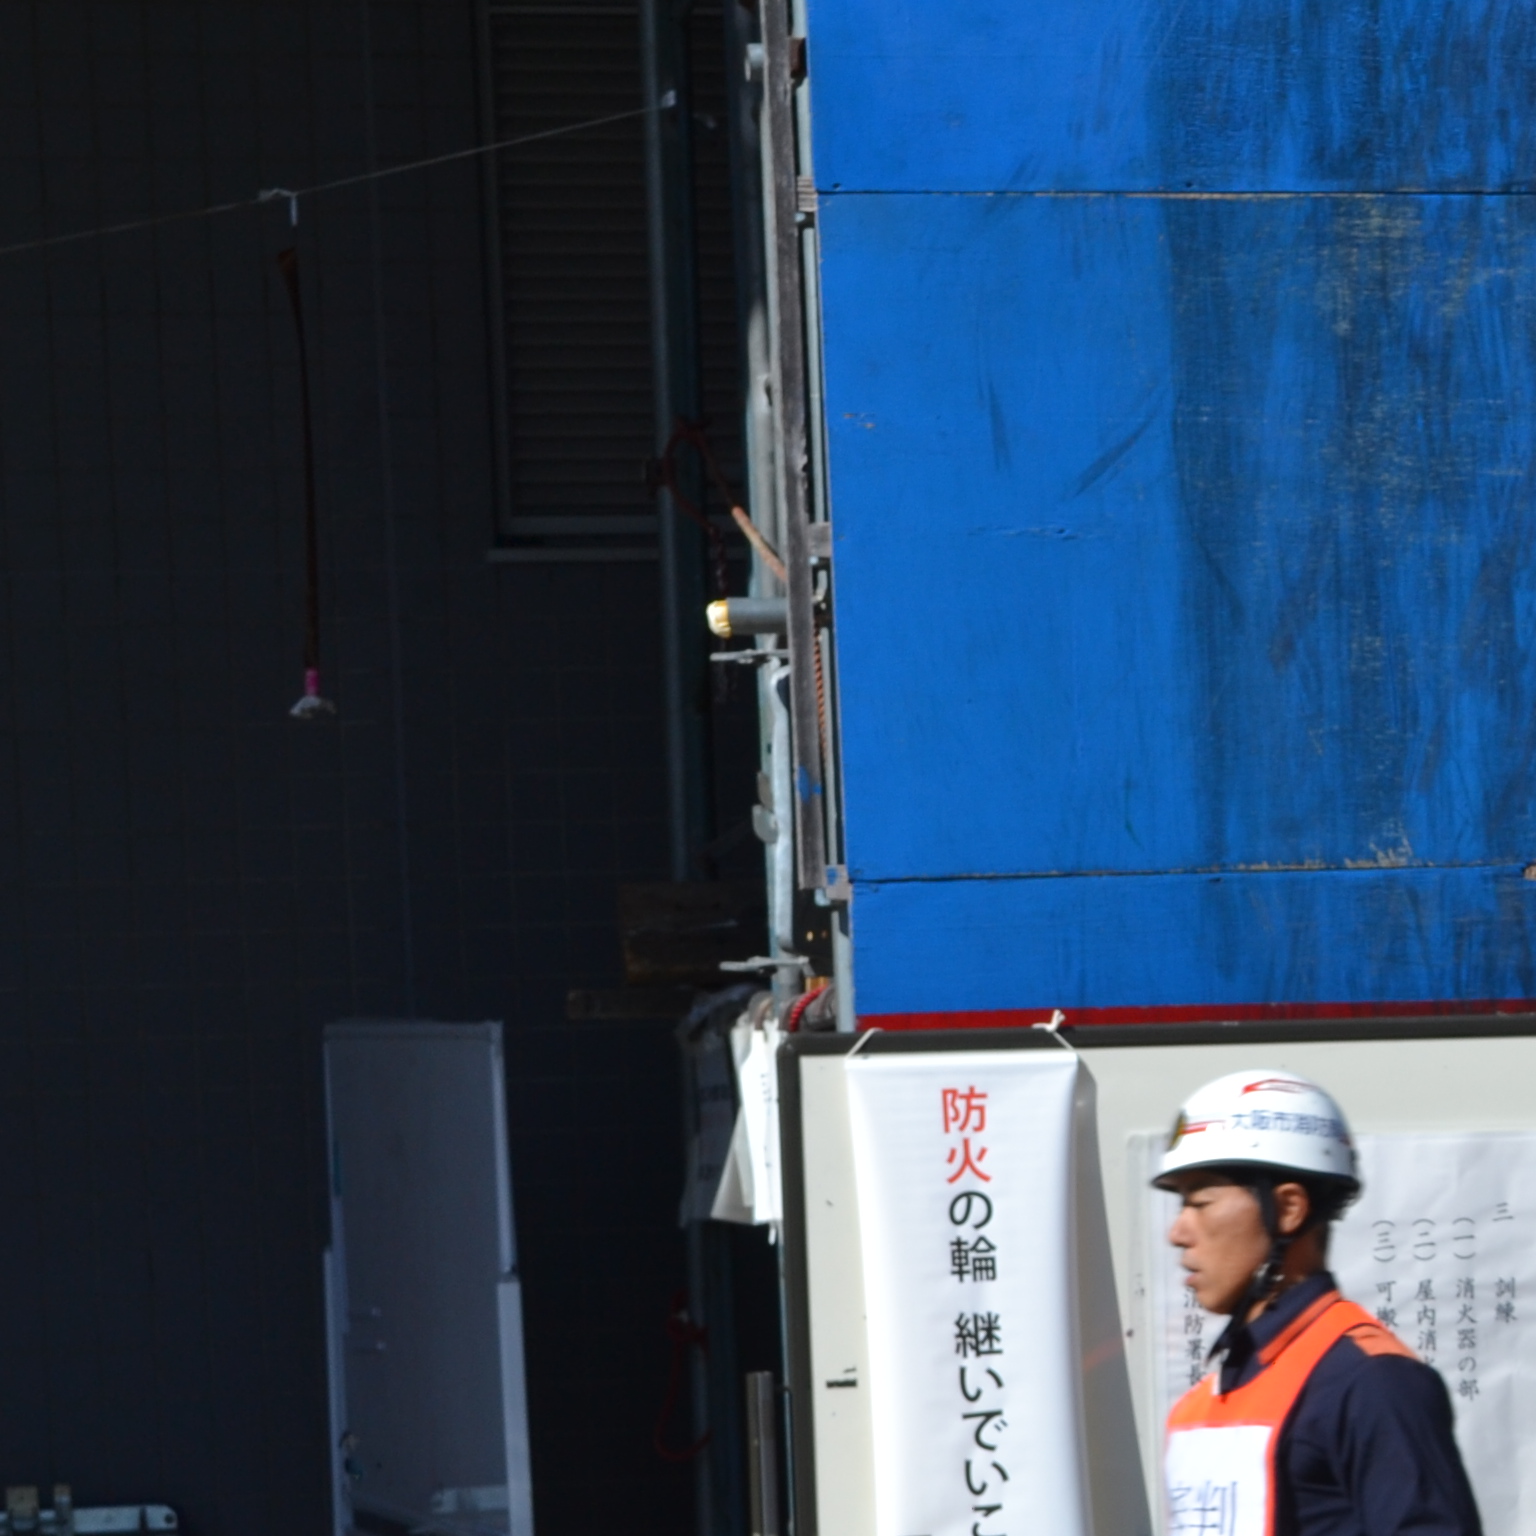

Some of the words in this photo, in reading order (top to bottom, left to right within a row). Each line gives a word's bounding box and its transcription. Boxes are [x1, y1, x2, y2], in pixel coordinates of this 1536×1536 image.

[941, 1086, 997, 1284] 防火の輪
[1455, 1277, 1479, 1401] 消火器の部
[1494, 1277, 1518, 1324] 訓練
